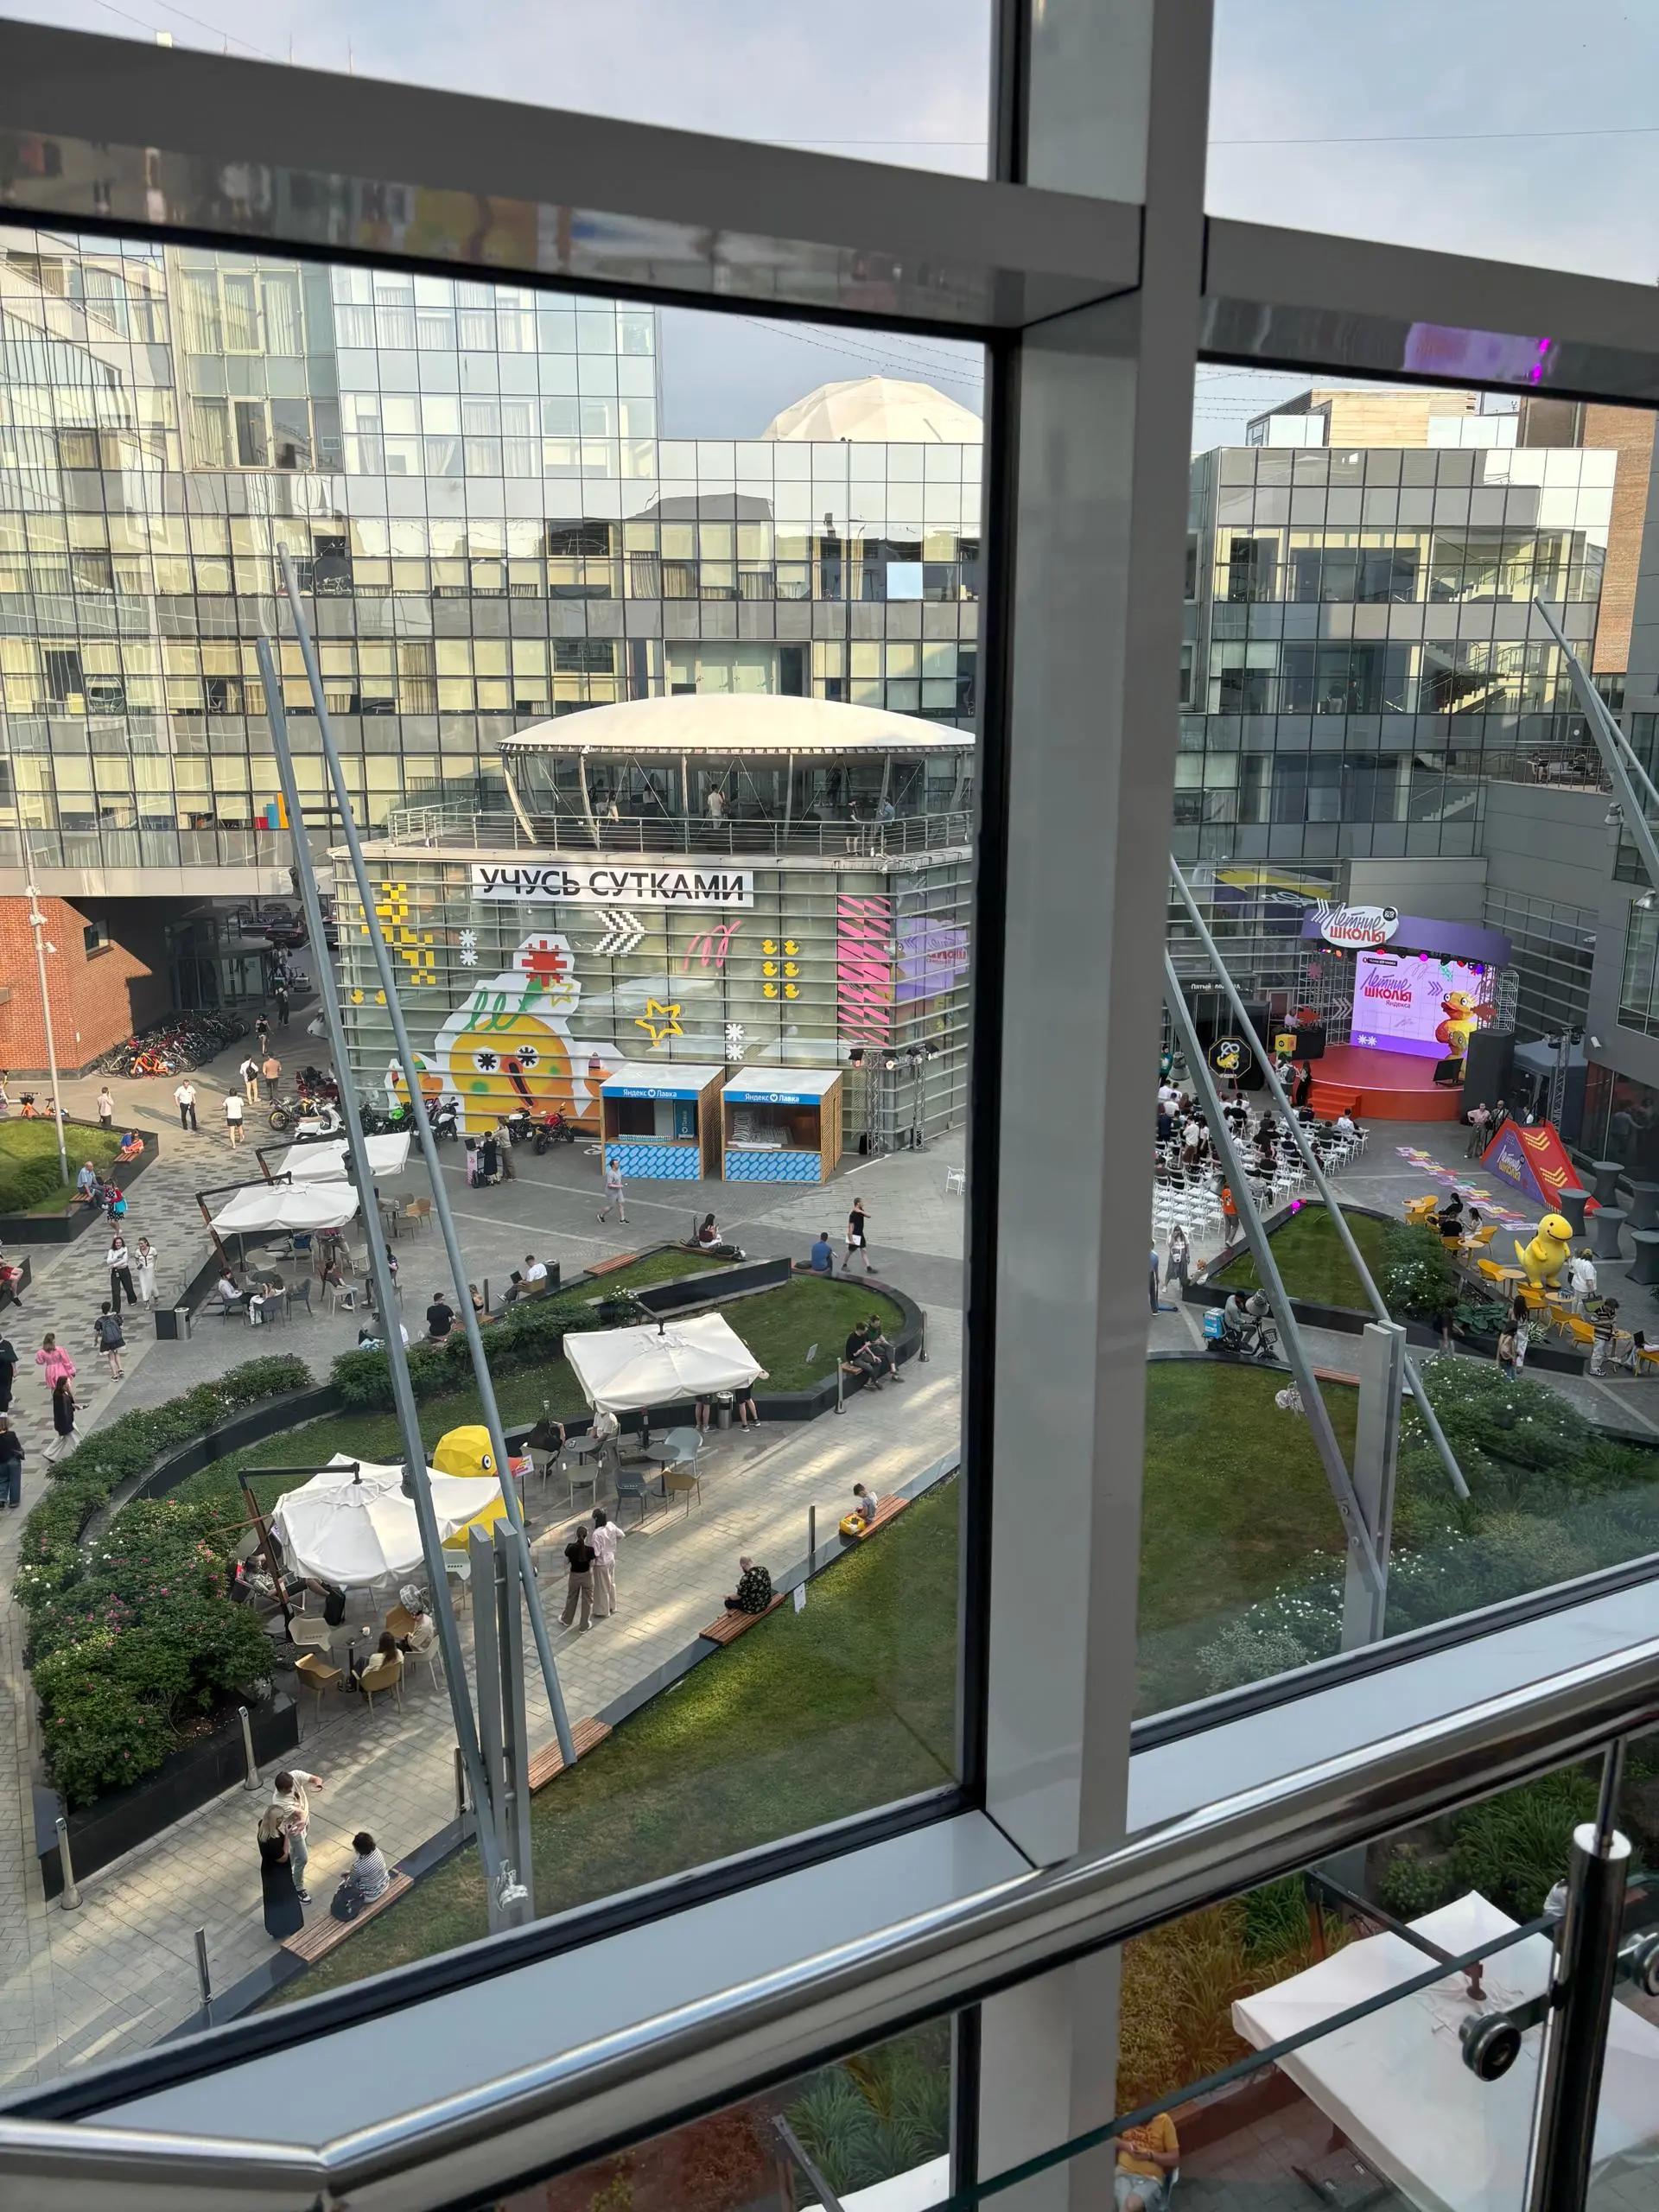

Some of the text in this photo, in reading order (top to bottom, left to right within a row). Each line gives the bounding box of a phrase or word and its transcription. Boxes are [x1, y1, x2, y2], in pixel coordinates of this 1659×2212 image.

[480, 868, 744, 901] УЧУСЬ СУТКАМИ
[1324, 902, 1386, 931] Летние
[1359, 967, 1412, 991] Летние
[1385, 1000, 1411, 1008] Яндекса
[623, 1088, 677, 1098] Яндекс Лавка
[745, 1093, 800, 1103] Яндекс Лавка
